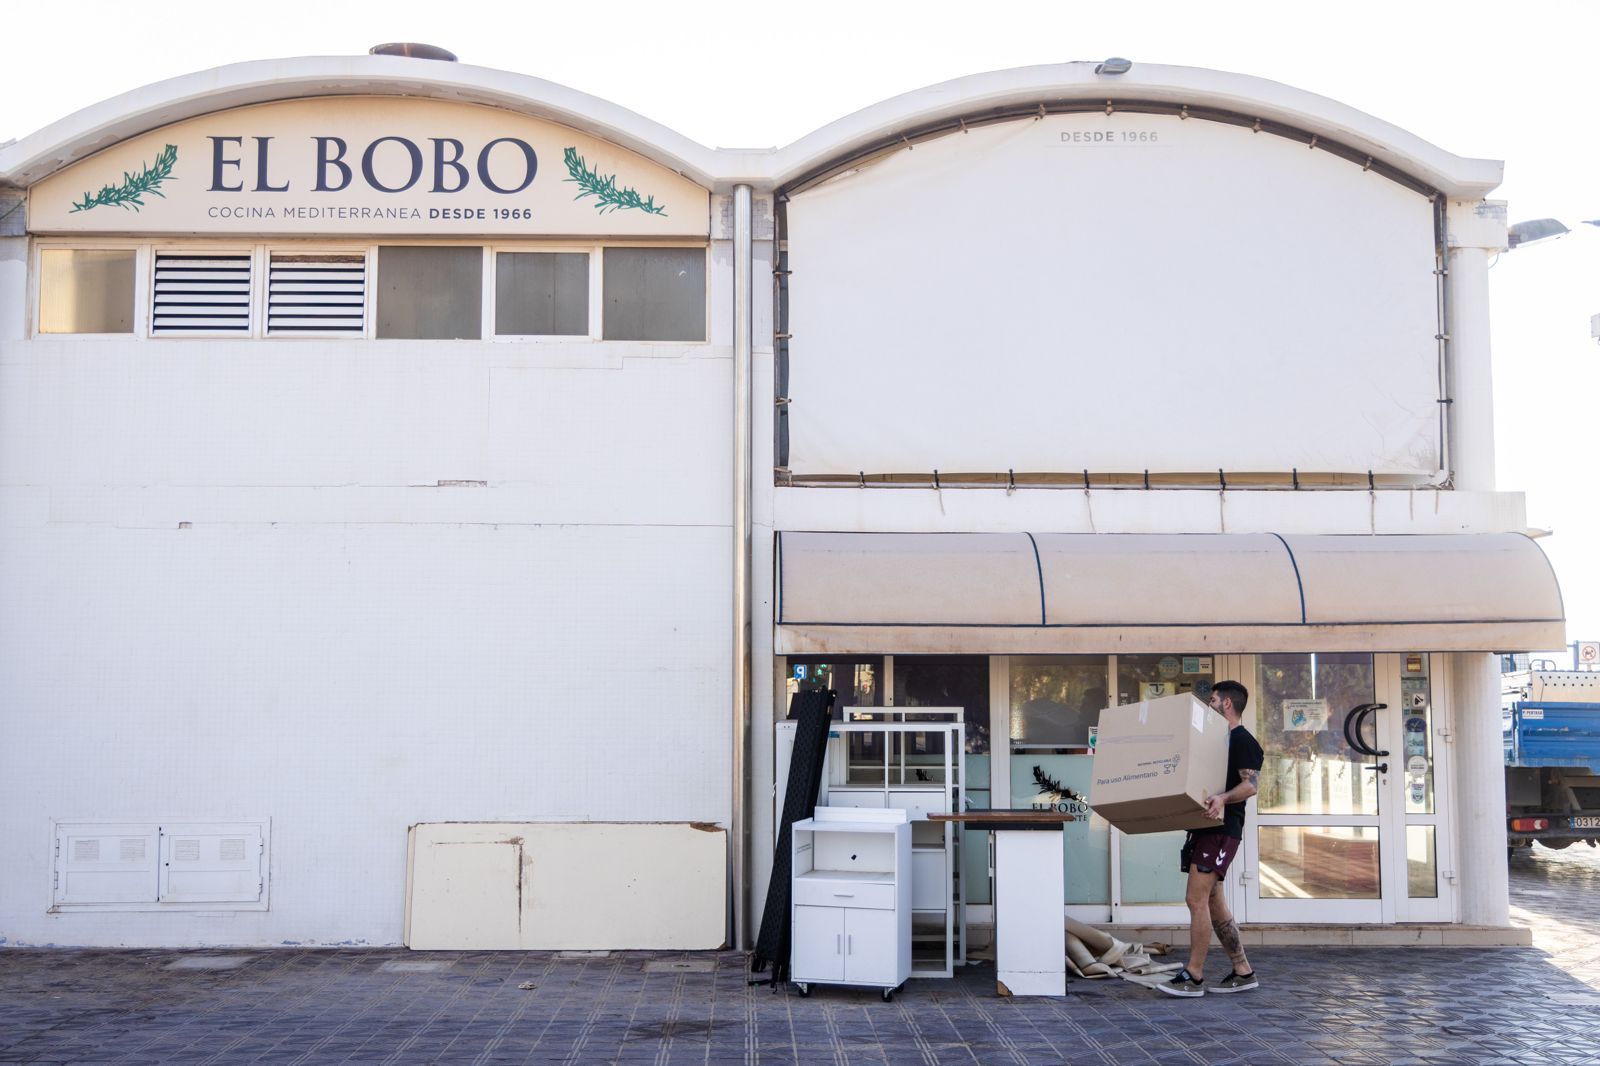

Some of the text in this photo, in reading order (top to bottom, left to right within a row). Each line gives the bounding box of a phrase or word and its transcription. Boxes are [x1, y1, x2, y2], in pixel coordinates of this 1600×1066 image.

[1060, 131, 1158, 142] DESDE 1966
[206, 135, 538, 194] EL BOBO
[207, 206, 532, 219] COCINA MEDITERRANEA DESDE 1966
[1097, 771, 1159, 786] Para uso Alimentario
[1576, 817, 1600, 827] 0312
